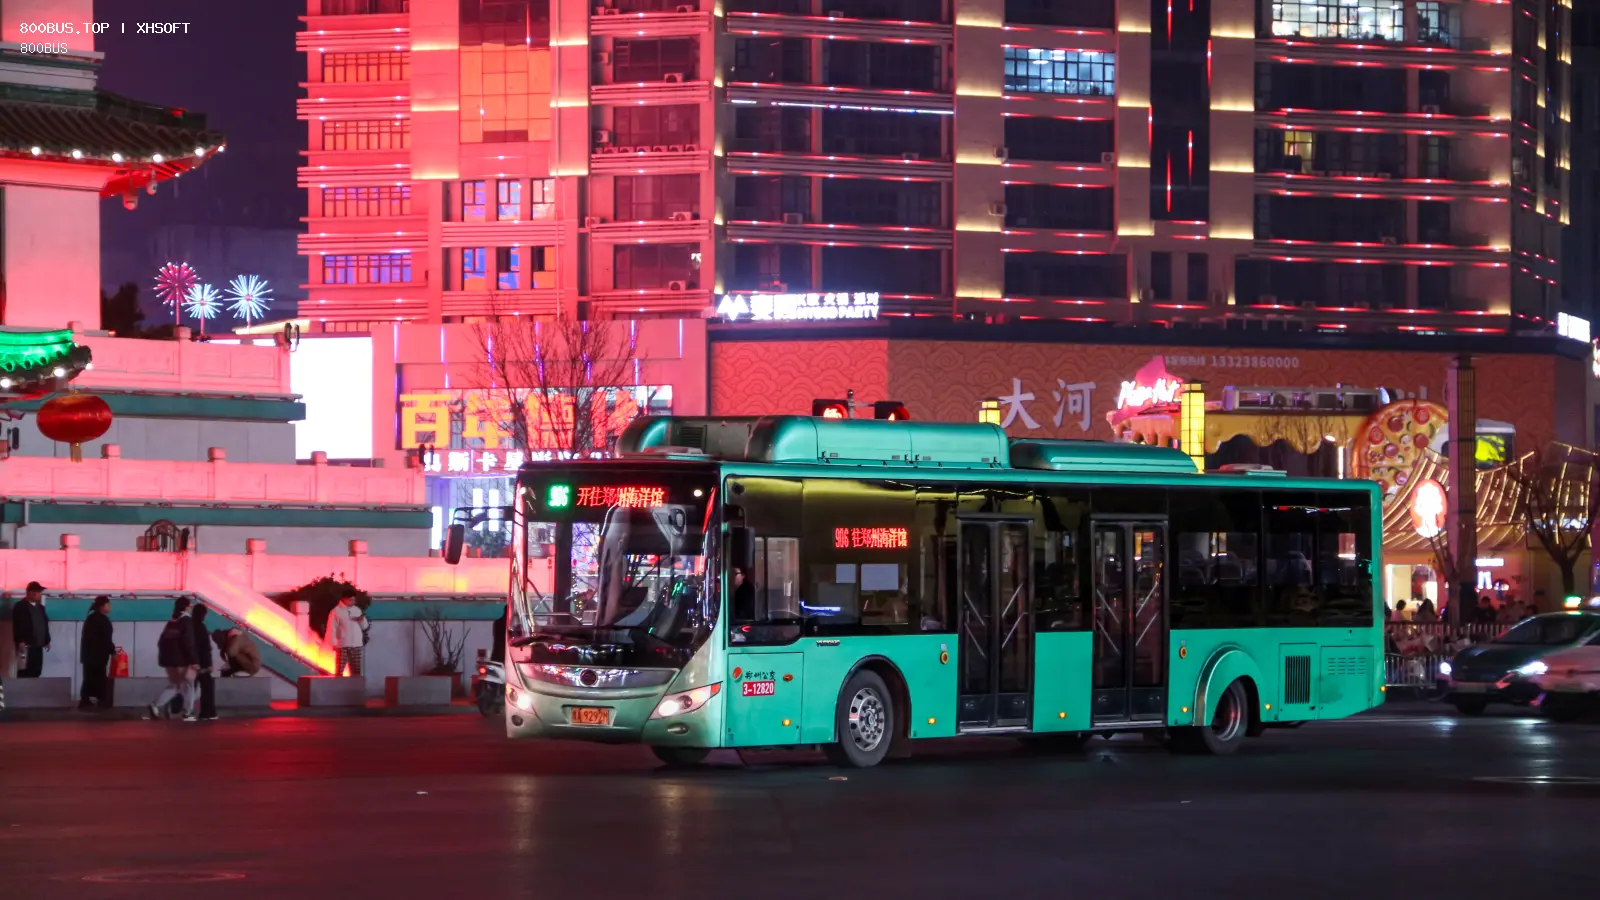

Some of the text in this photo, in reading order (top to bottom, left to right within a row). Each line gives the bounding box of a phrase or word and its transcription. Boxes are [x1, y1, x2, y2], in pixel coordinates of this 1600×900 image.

[1211, 356, 1300, 368] 13323860000
[999, 377, 1097, 431] 大河
[576, 486, 665, 508] 开往郑州海洋馆
[835, 528, 849, 548] 906
[744, 671, 776, 681] 郑州公交
[743, 682, 774, 695] 3-12820
